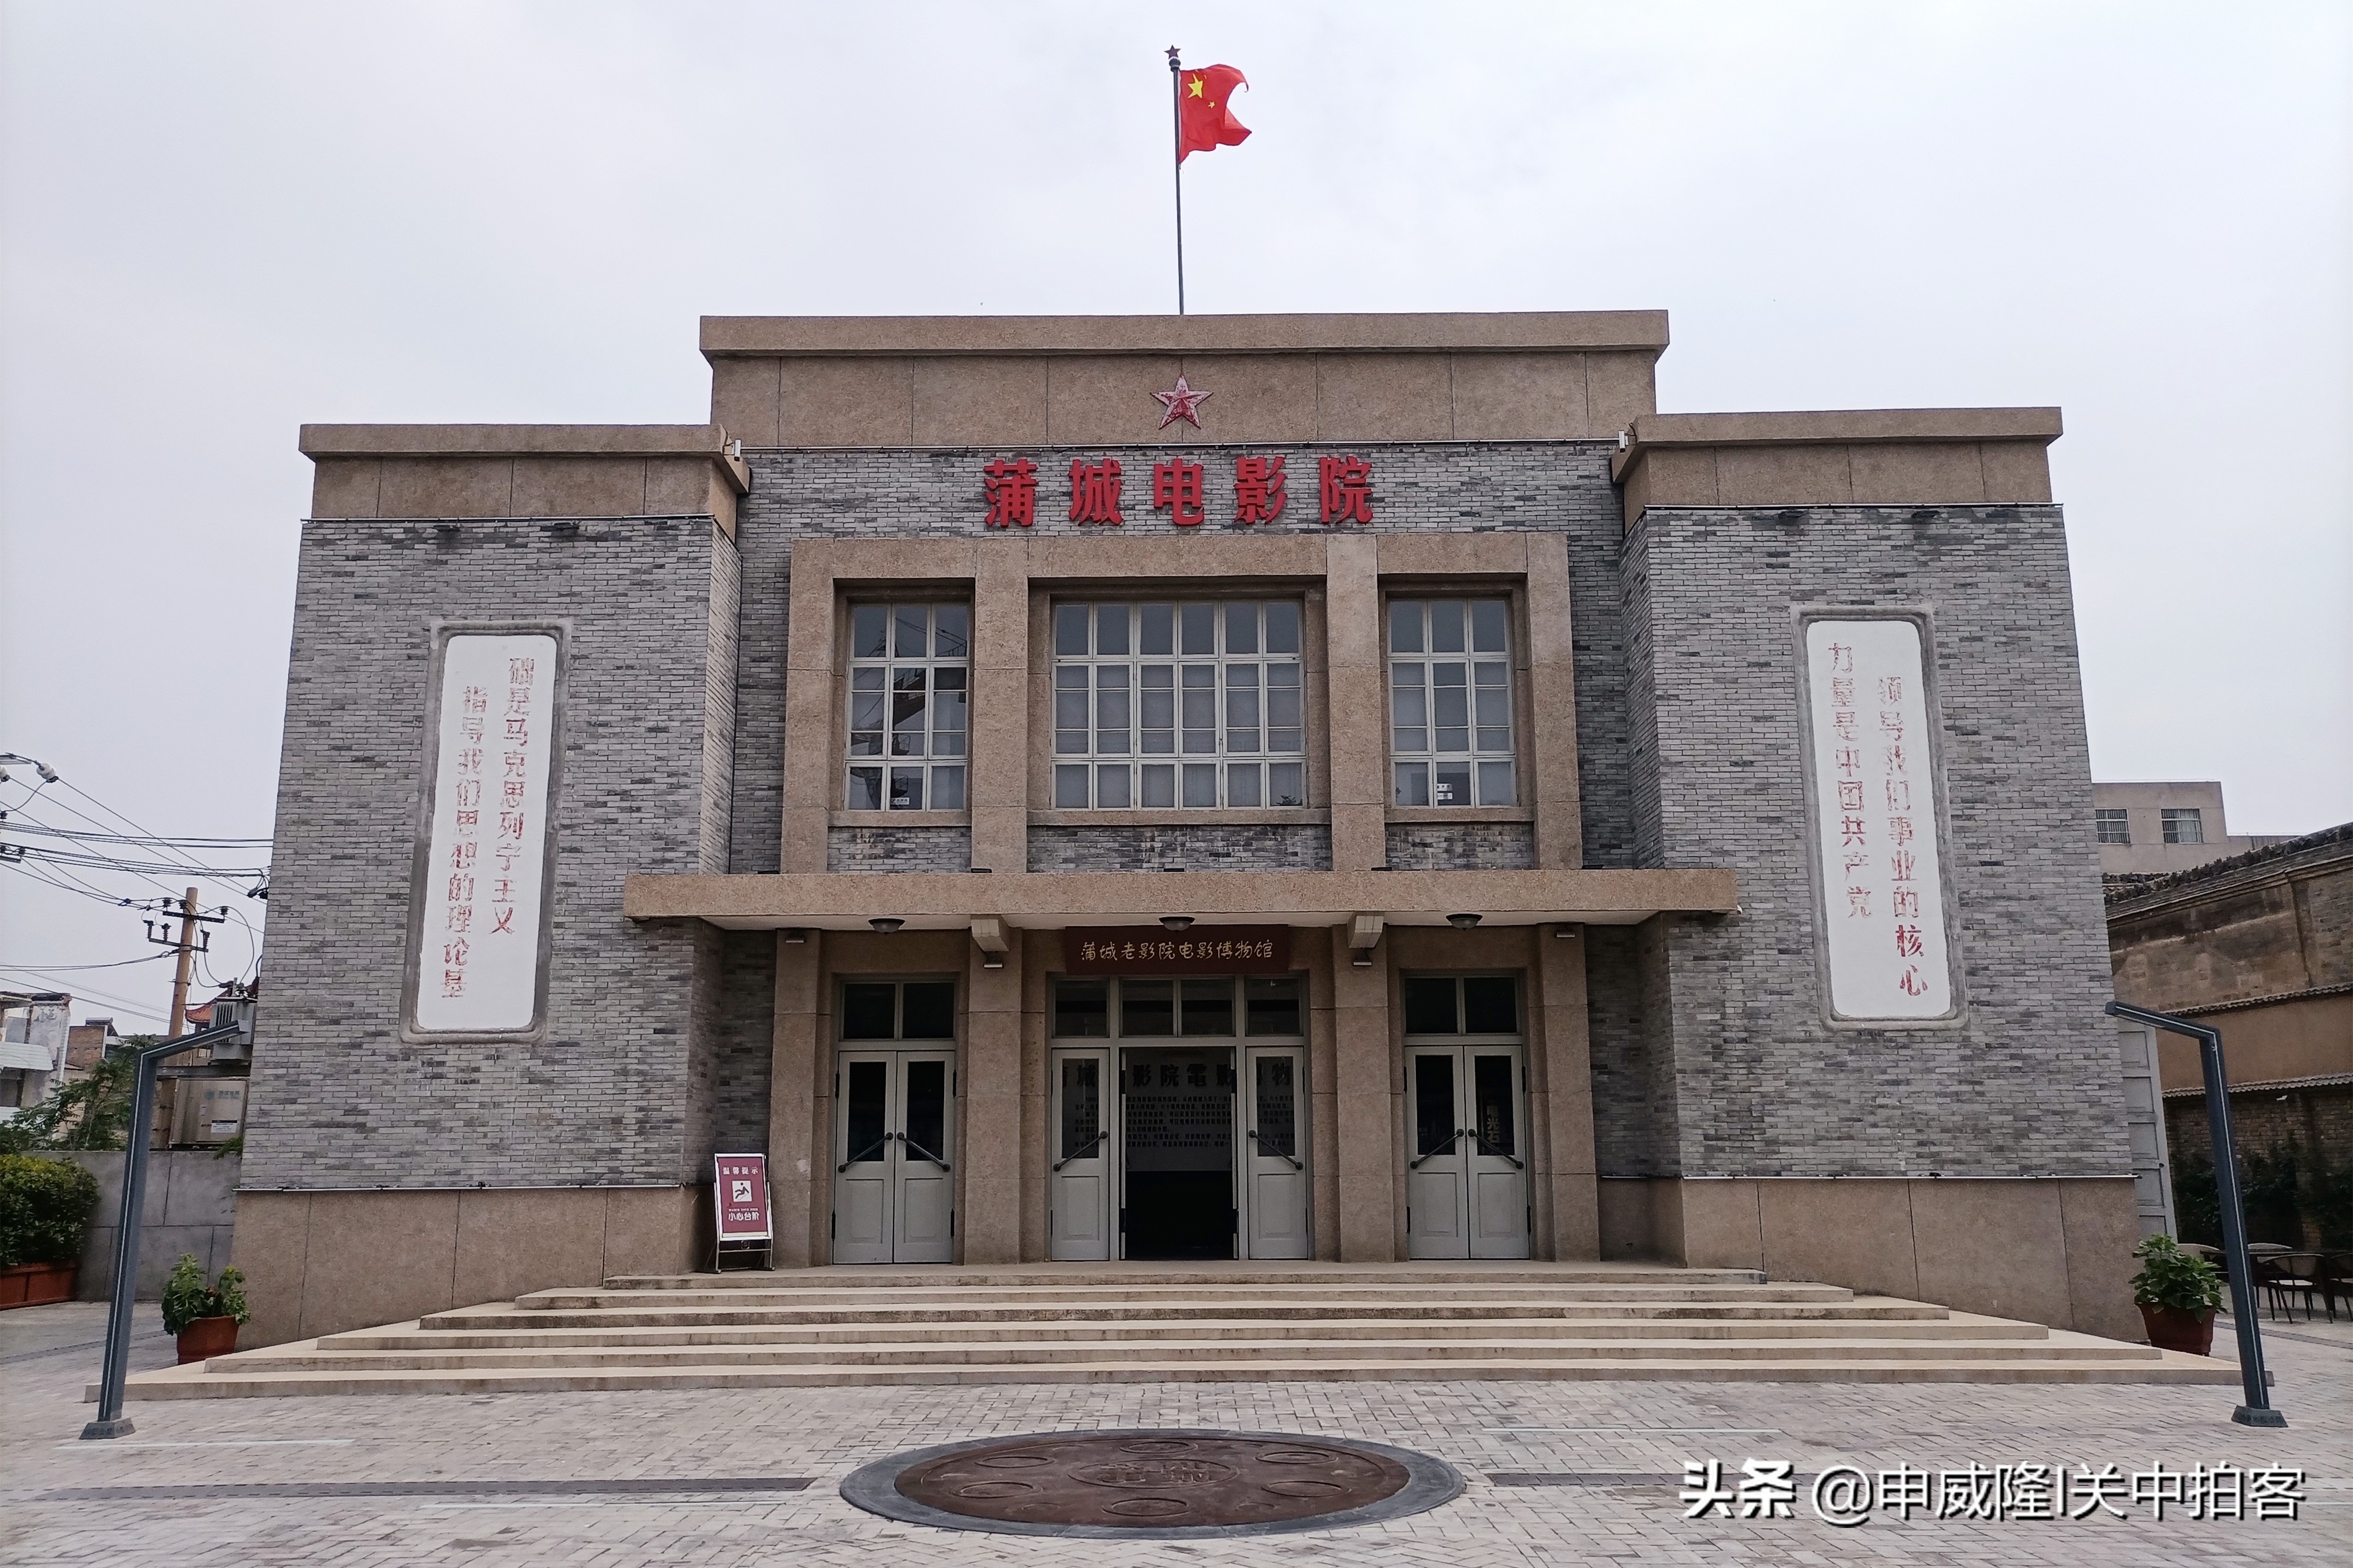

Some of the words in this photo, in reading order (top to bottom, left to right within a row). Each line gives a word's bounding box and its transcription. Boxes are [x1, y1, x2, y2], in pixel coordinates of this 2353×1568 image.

[983, 456, 1372, 527] 蒲城电影院
[1828, 642, 1873, 919] 力量是中国共产党
[1081, 939, 1273, 961] 蒲城老影院电影博物馆
[728, 1212, 759, 1221] 小心台阶
